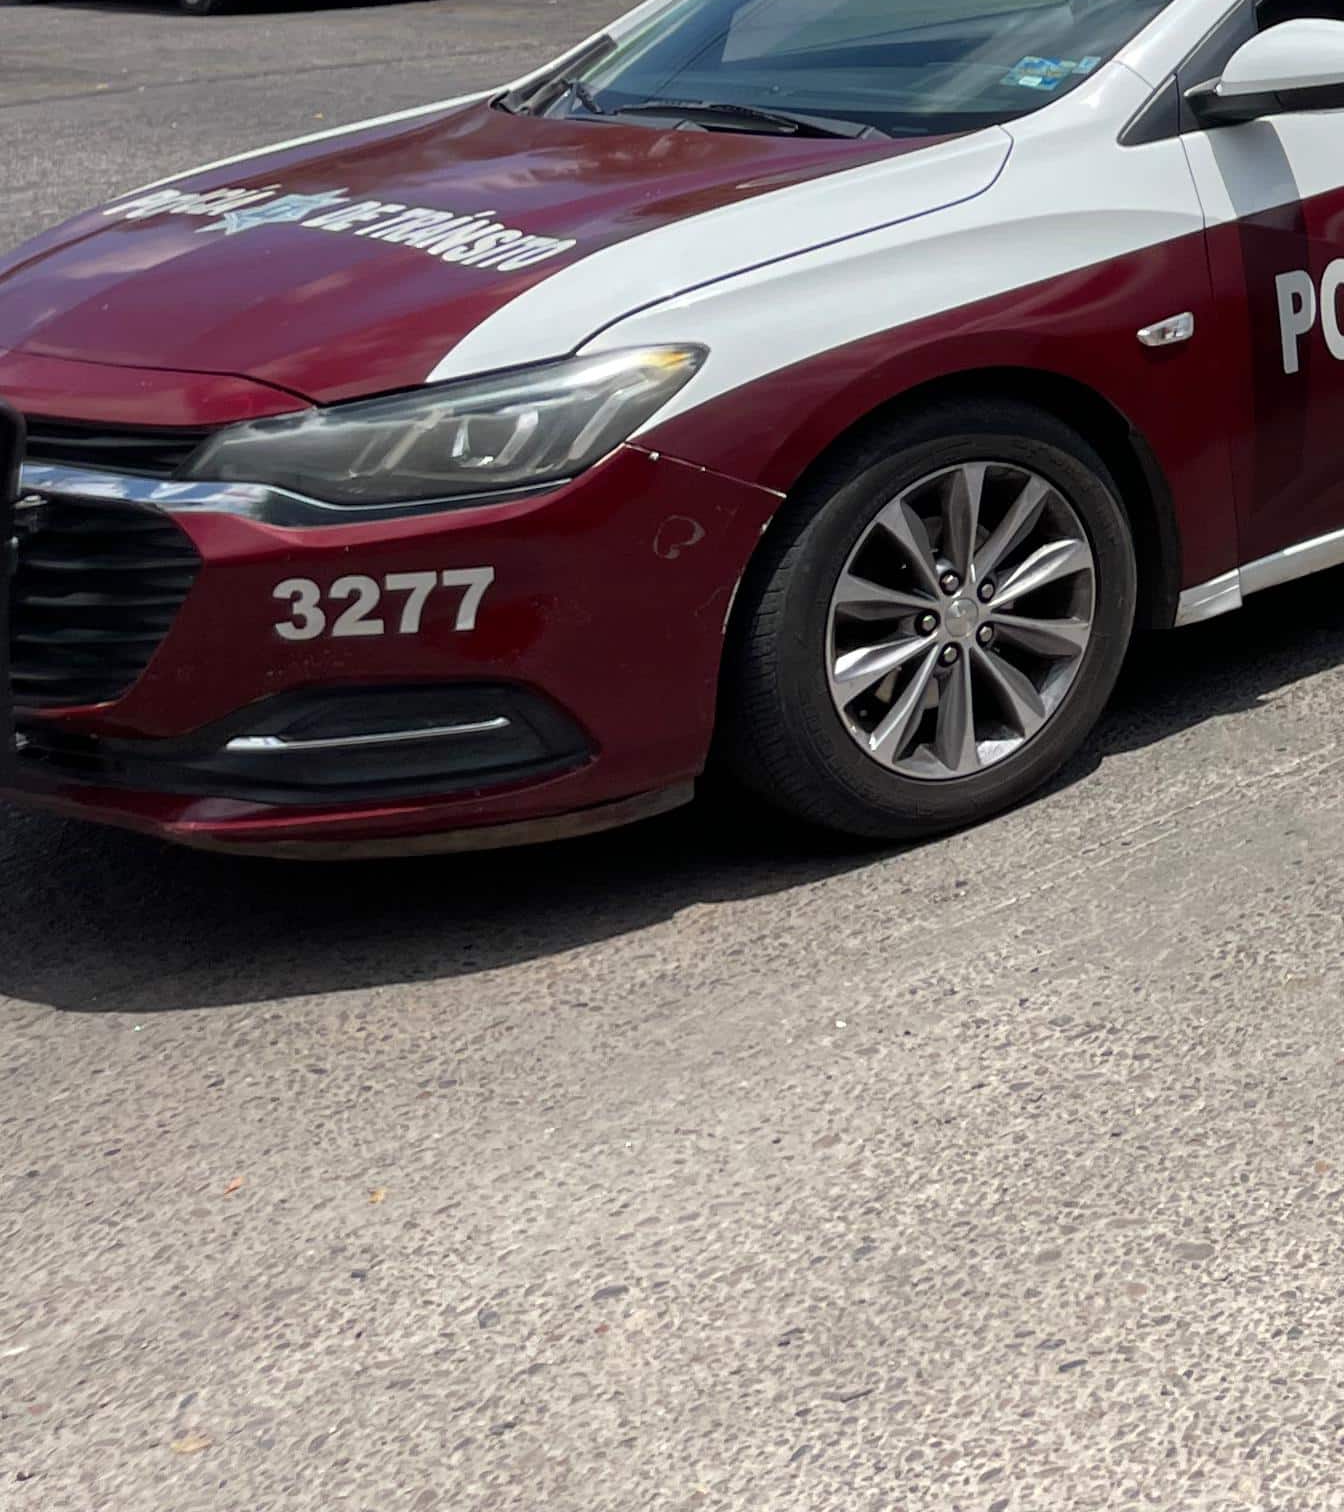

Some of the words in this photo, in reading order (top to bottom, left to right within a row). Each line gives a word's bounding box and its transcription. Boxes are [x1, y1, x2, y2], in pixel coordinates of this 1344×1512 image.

[301, 201, 406, 231] DE
[353, 210, 577, 271] TRÁNSITO
[272, 566, 495, 641] 3277
